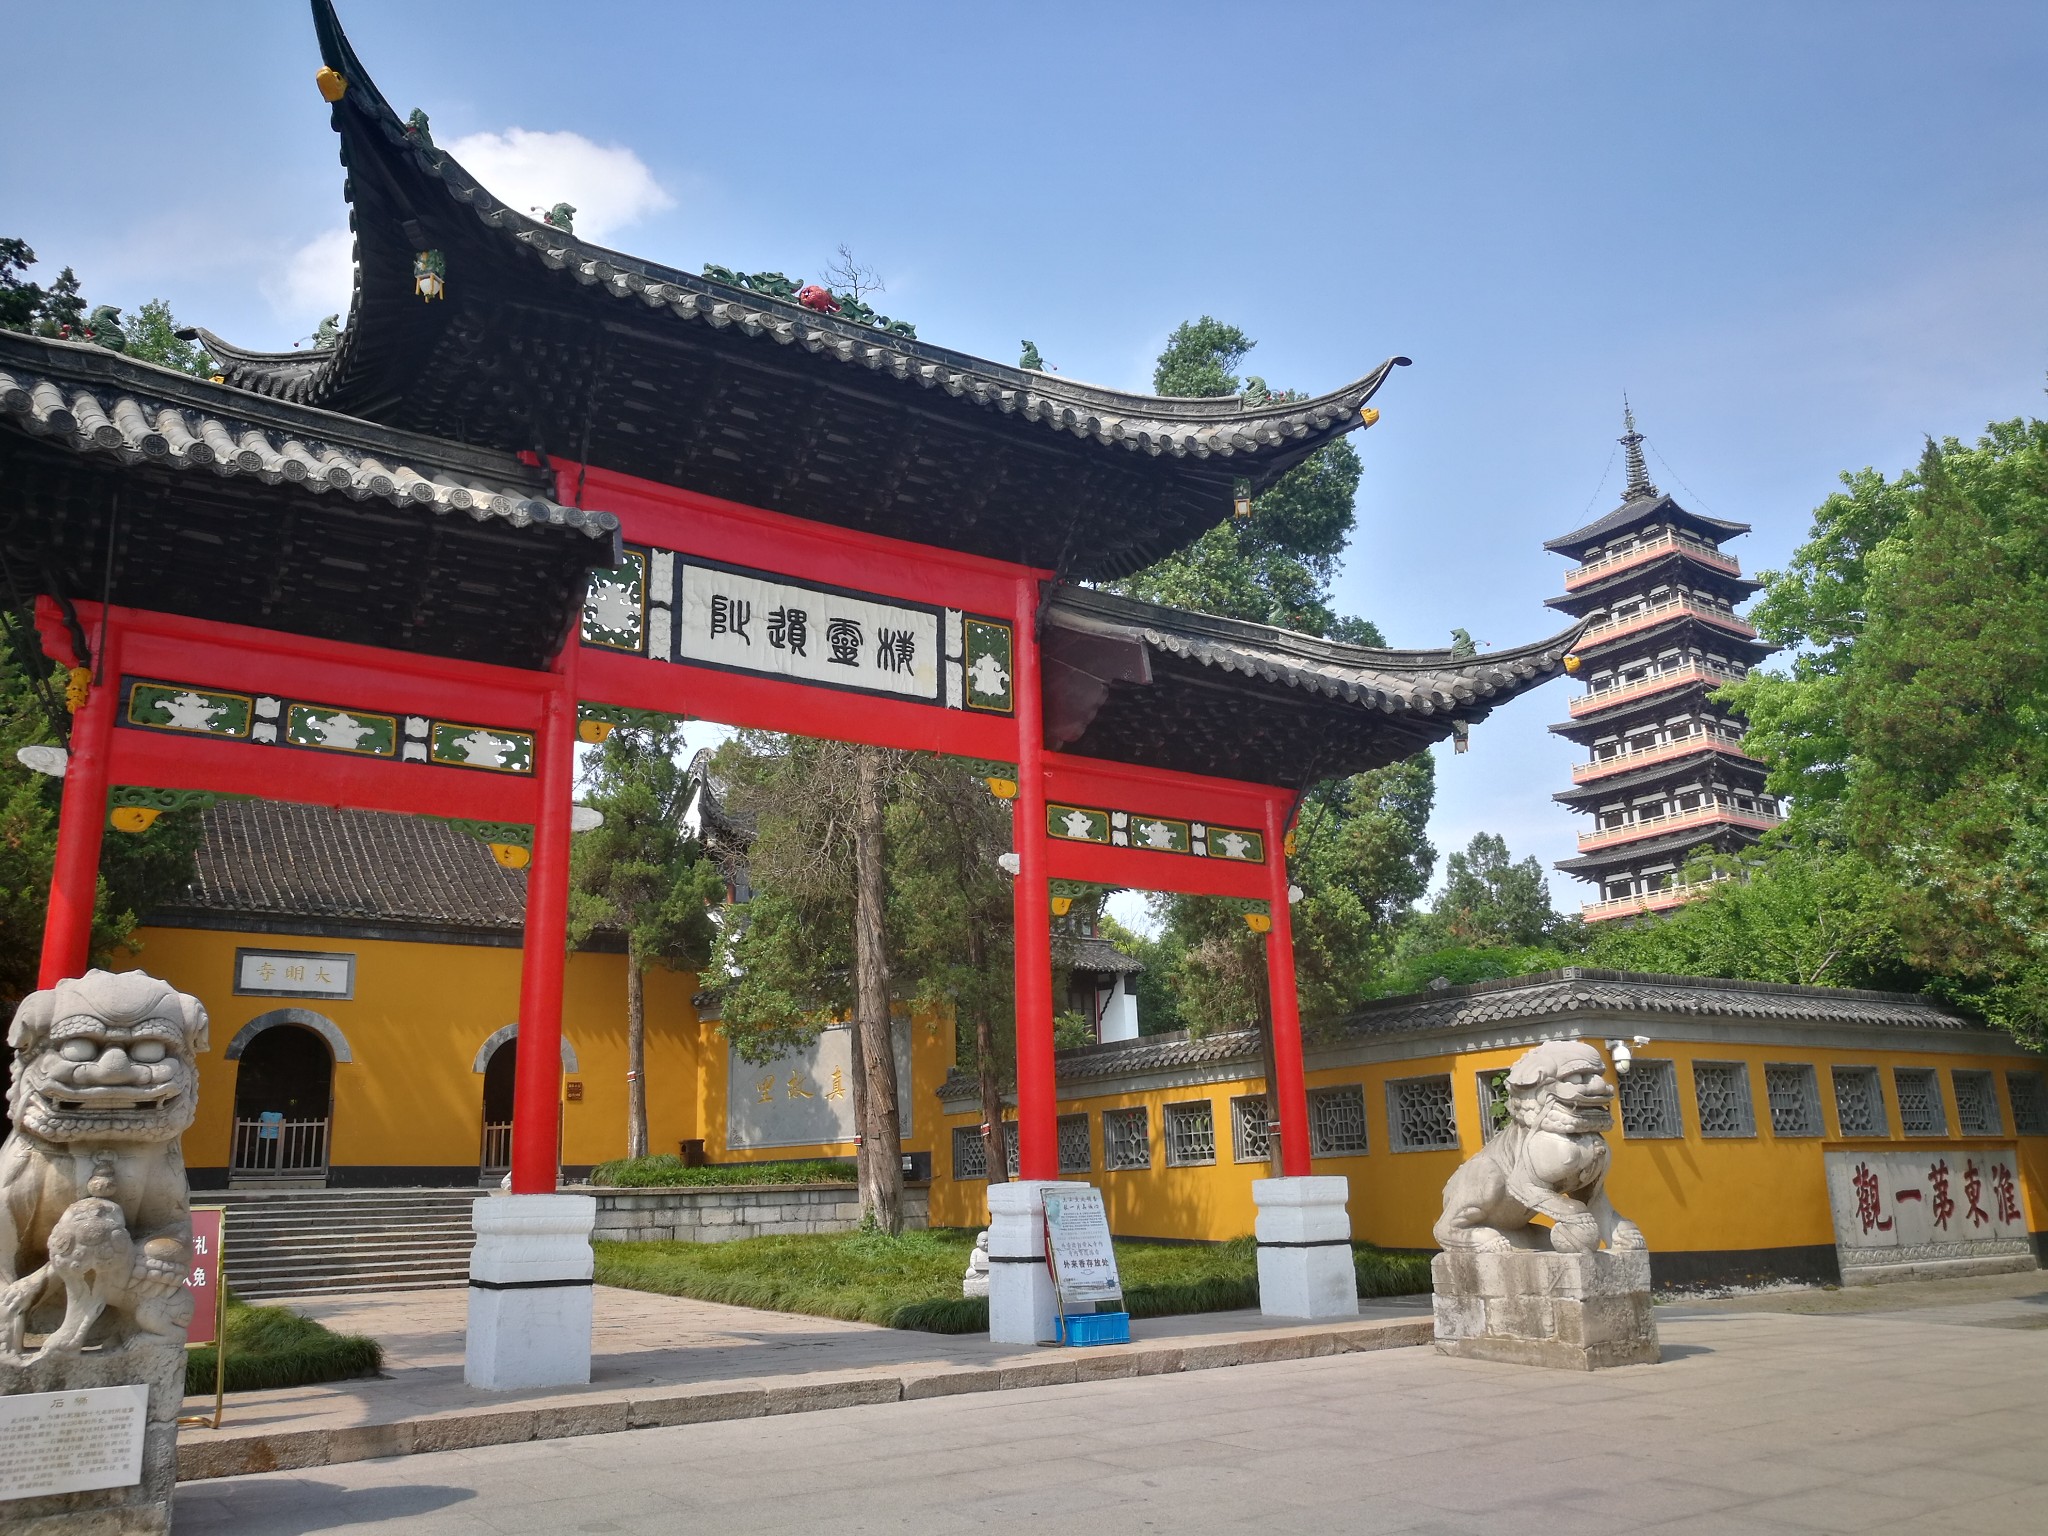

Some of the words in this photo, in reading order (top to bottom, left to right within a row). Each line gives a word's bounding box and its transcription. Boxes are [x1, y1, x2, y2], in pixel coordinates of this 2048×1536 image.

[256, 962, 332, 983] 大明寺
[756, 1064, 846, 1104] 真故里
